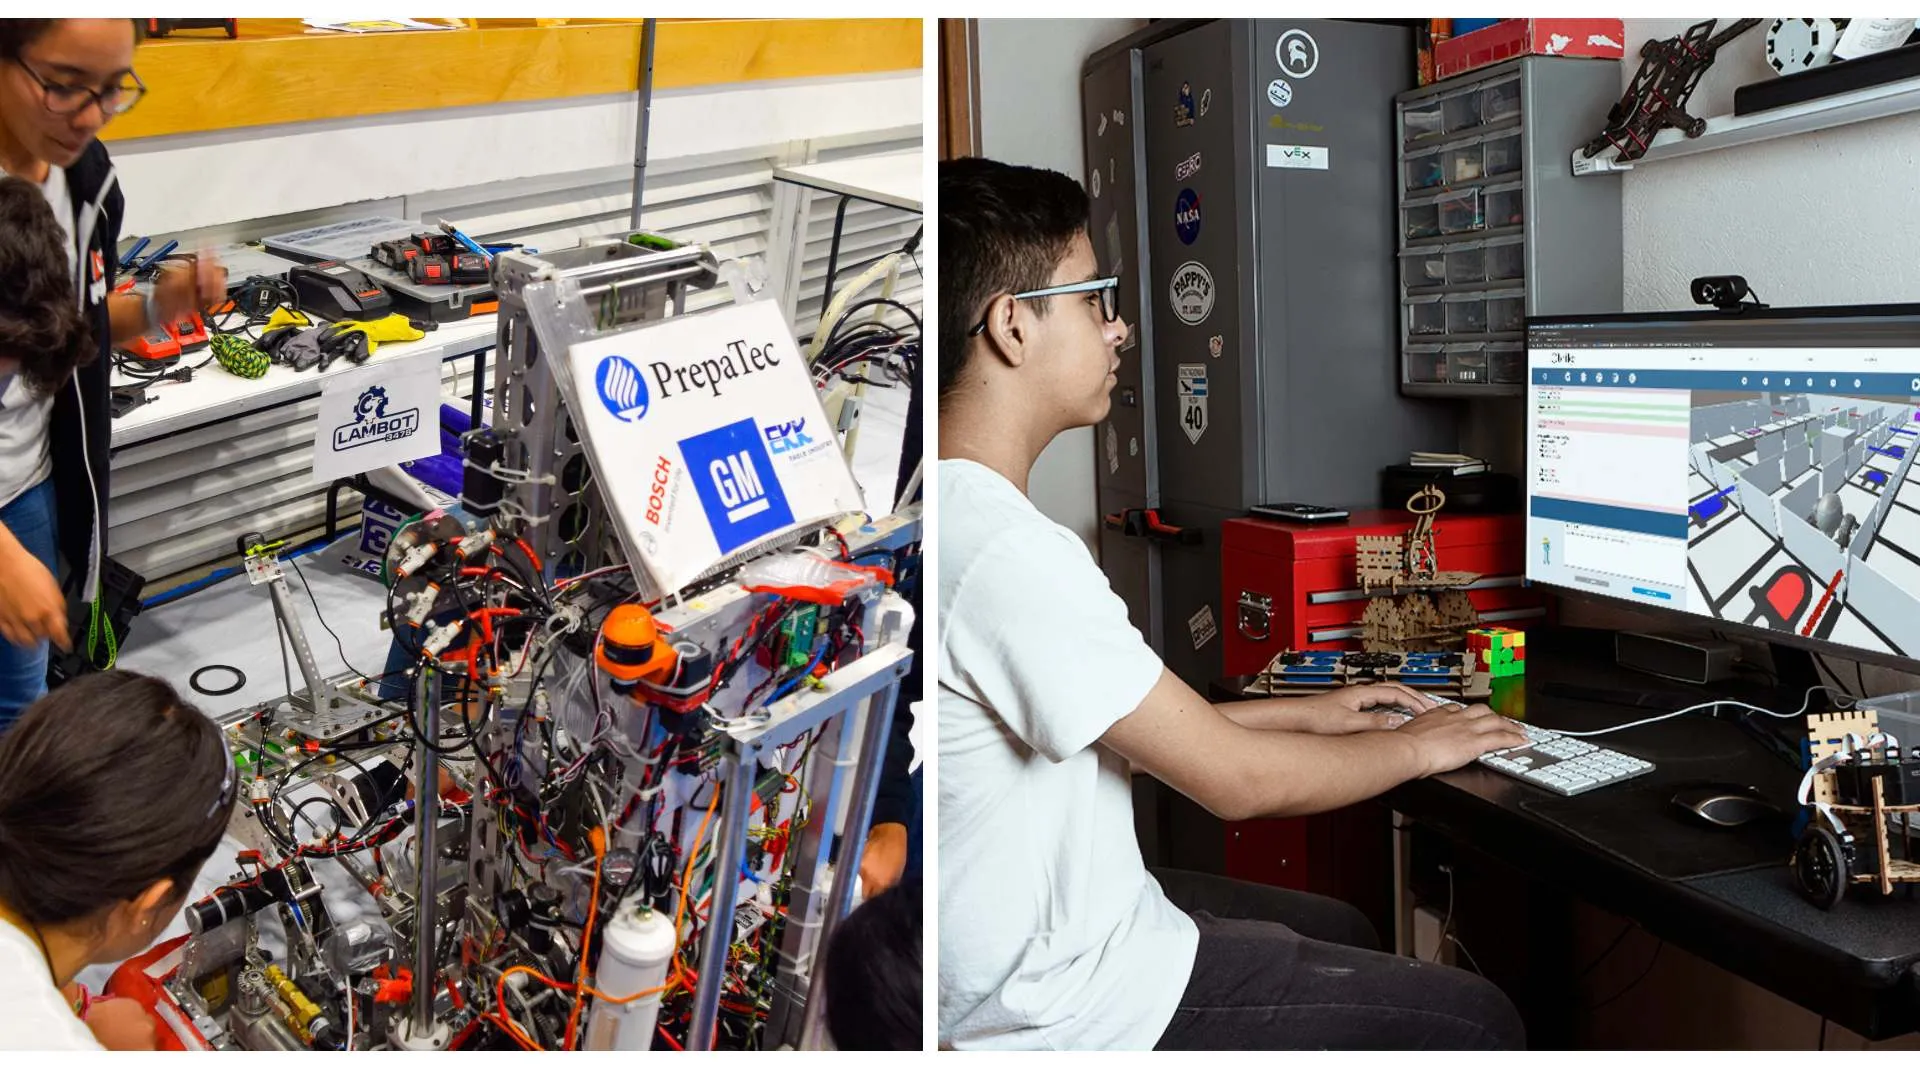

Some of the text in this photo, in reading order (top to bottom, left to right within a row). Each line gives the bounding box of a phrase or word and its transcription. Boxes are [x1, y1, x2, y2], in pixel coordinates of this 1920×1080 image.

[1283, 146, 1311, 159] VEX
[1176, 209, 1200, 225] NASA
[1174, 271, 1211, 298] PAPPY'S
[648, 339, 781, 399] PrepaTec
[338, 414, 415, 444] LAMBOT
[1185, 405, 1203, 430] 40
[645, 455, 671, 525] BOSCH
[708, 450, 766, 509] GM
